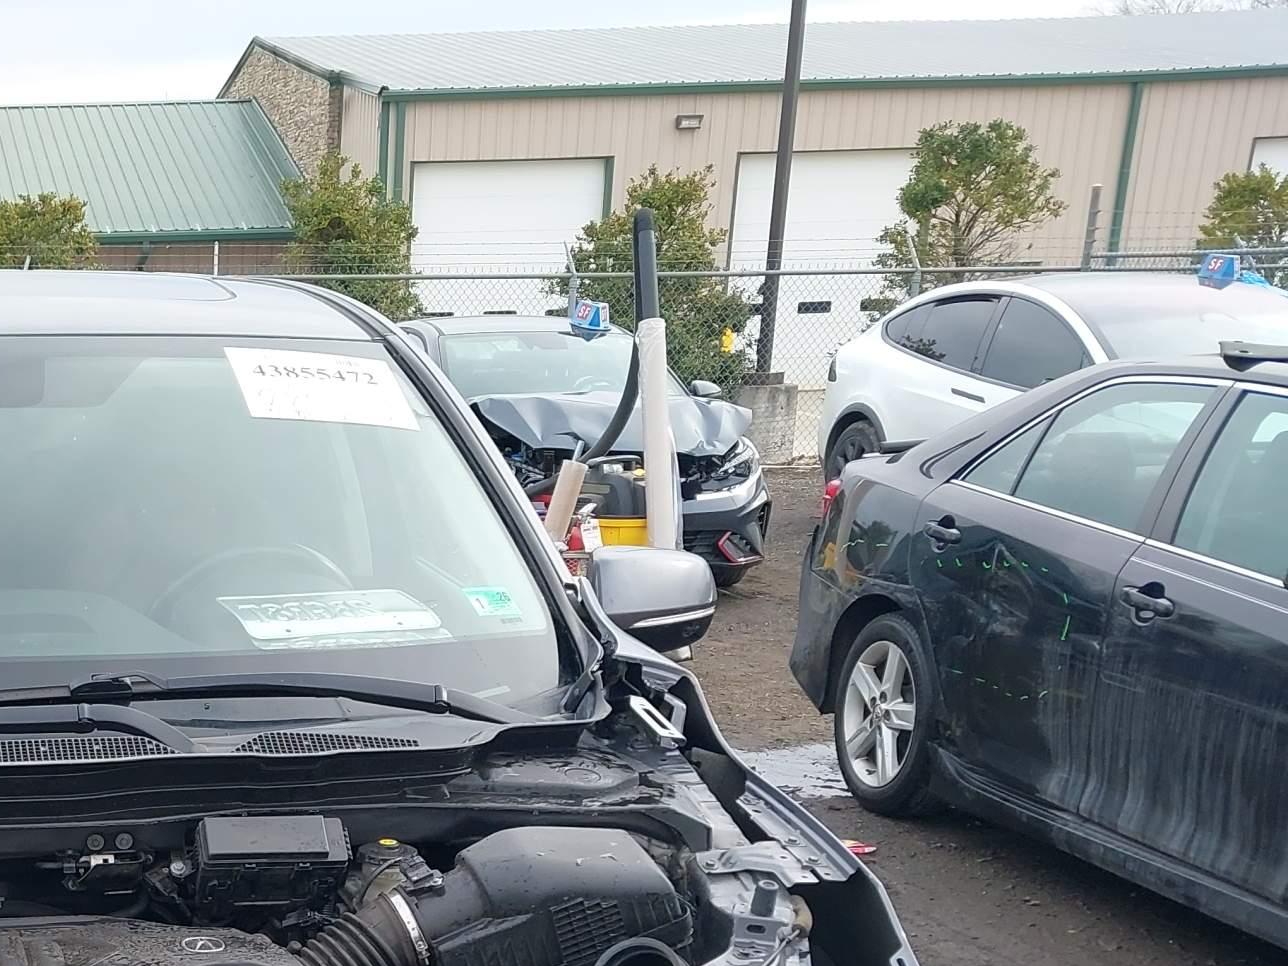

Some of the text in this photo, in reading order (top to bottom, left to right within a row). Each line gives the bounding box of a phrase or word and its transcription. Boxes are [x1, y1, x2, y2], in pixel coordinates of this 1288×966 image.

[1208, 258, 1224, 271] SF
[578, 305, 591, 318] SF
[252, 364, 379, 385] 43855472
